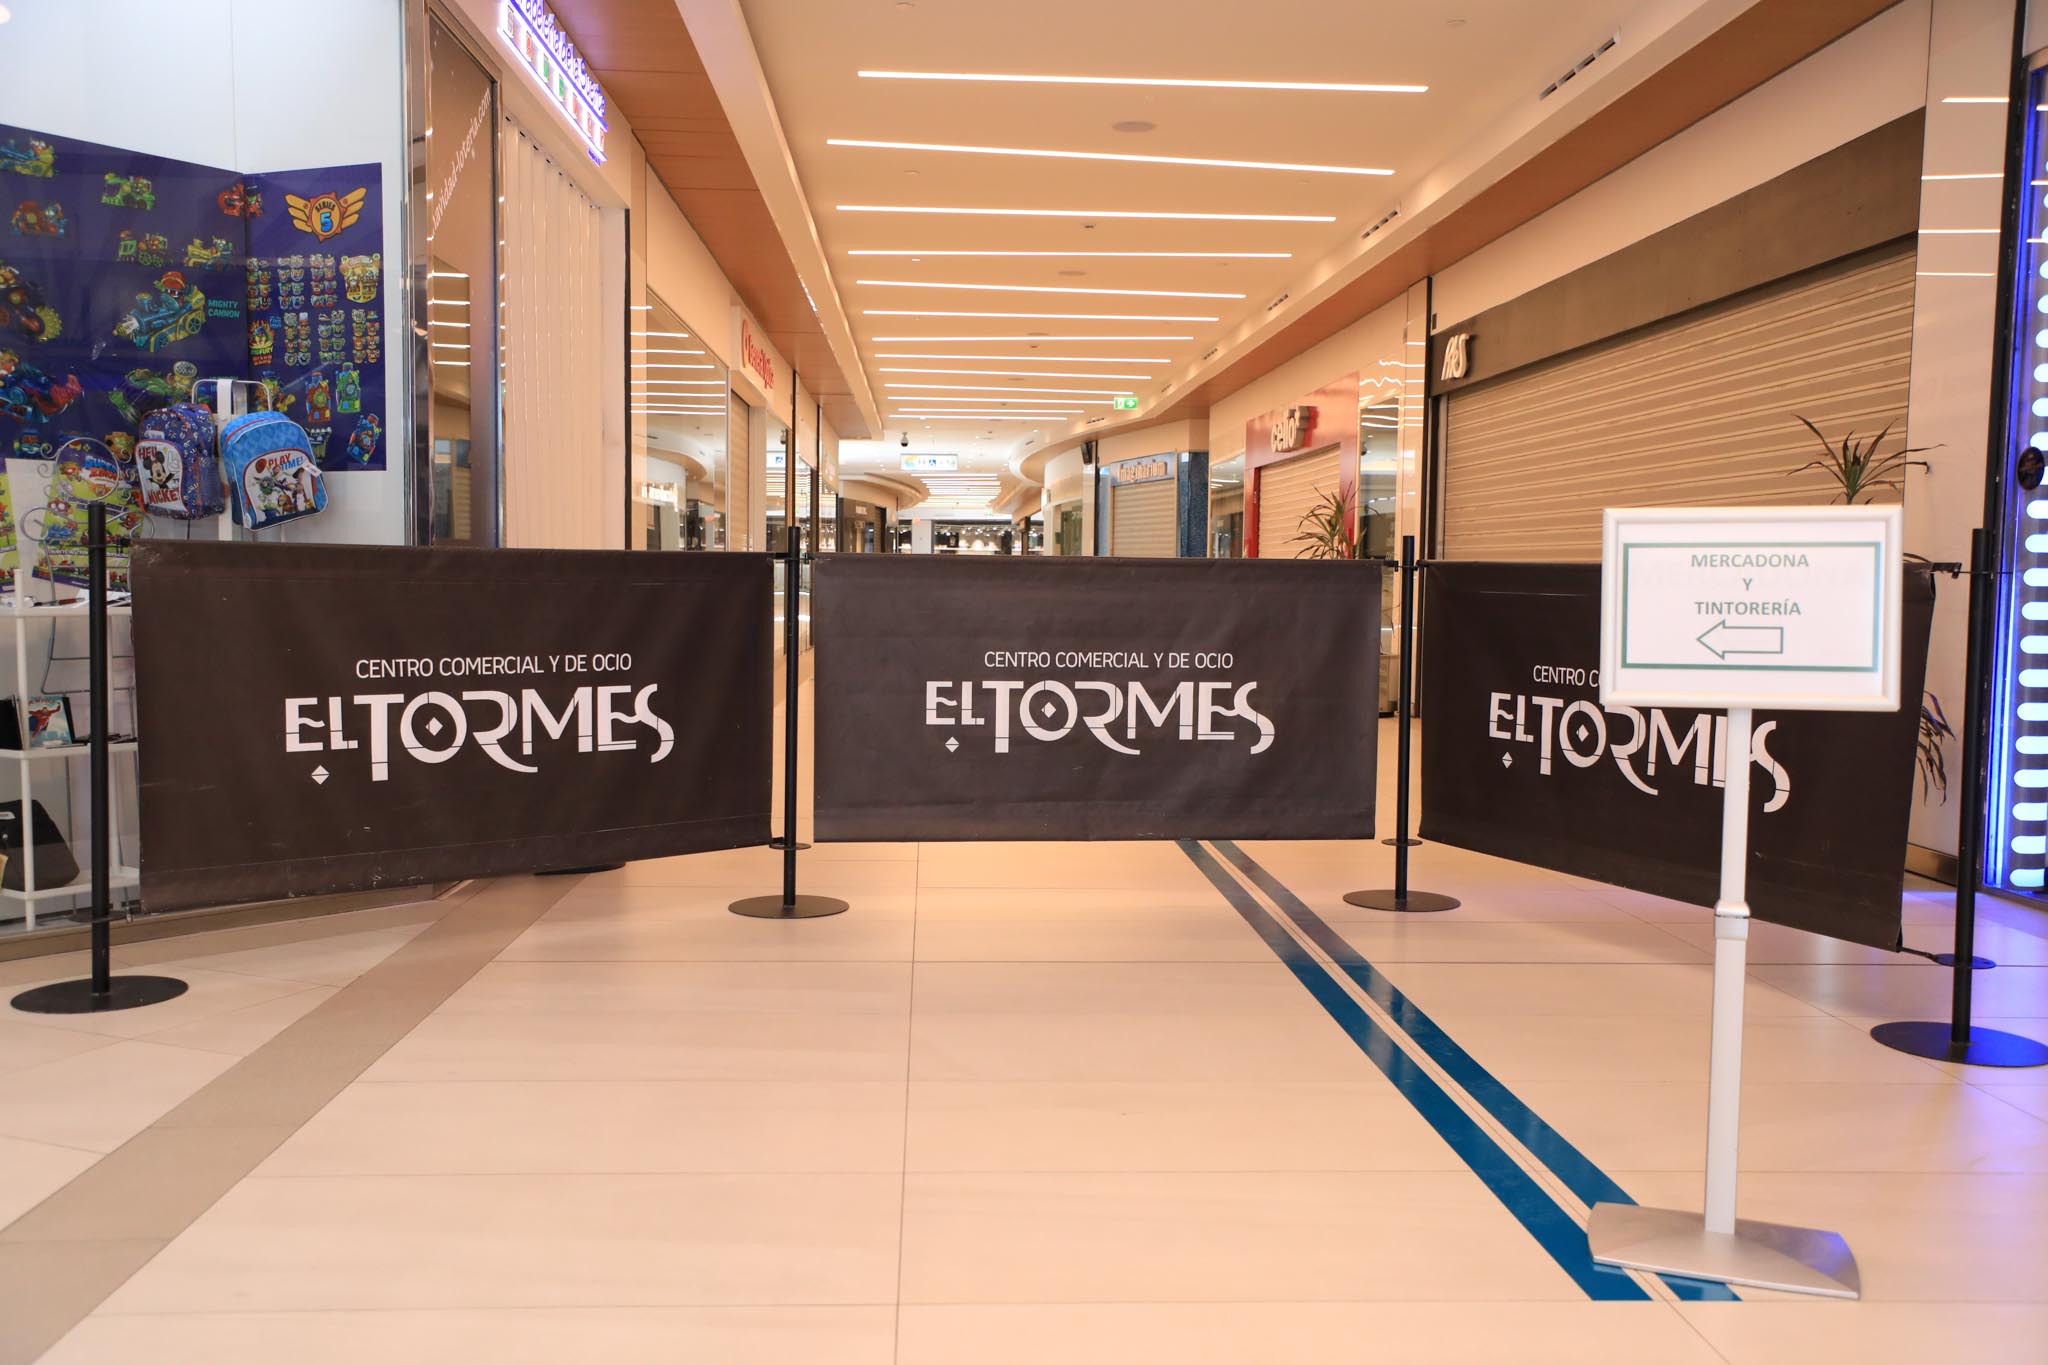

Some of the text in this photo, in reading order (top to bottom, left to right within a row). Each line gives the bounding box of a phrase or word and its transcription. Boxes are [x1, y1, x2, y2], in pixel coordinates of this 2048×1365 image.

[314, 201, 336, 212] SERIES
[319, 211, 333, 232] 5
[207, 299, 239, 309] MIGHTY
[207, 309, 240, 319] CANNON
[268, 453, 291, 467] PLAY
[1691, 554, 1809, 568] MERCADONA
[1743, 578, 1753, 591] Y
[1695, 598, 1801, 616] TINTORERÍA
[356, 653, 632, 679] CENTRO COMERCIAL Y DE OCIO
[984, 651, 1234, 669] CENTRO COMERCIAL Y DE OCIO
[1533, 665, 1586, 687] CENTRO
[925, 679, 1275, 756] EL TORMES
[1489, 691, 1534, 743] EL
[285, 683, 675, 783] EL TORMES
